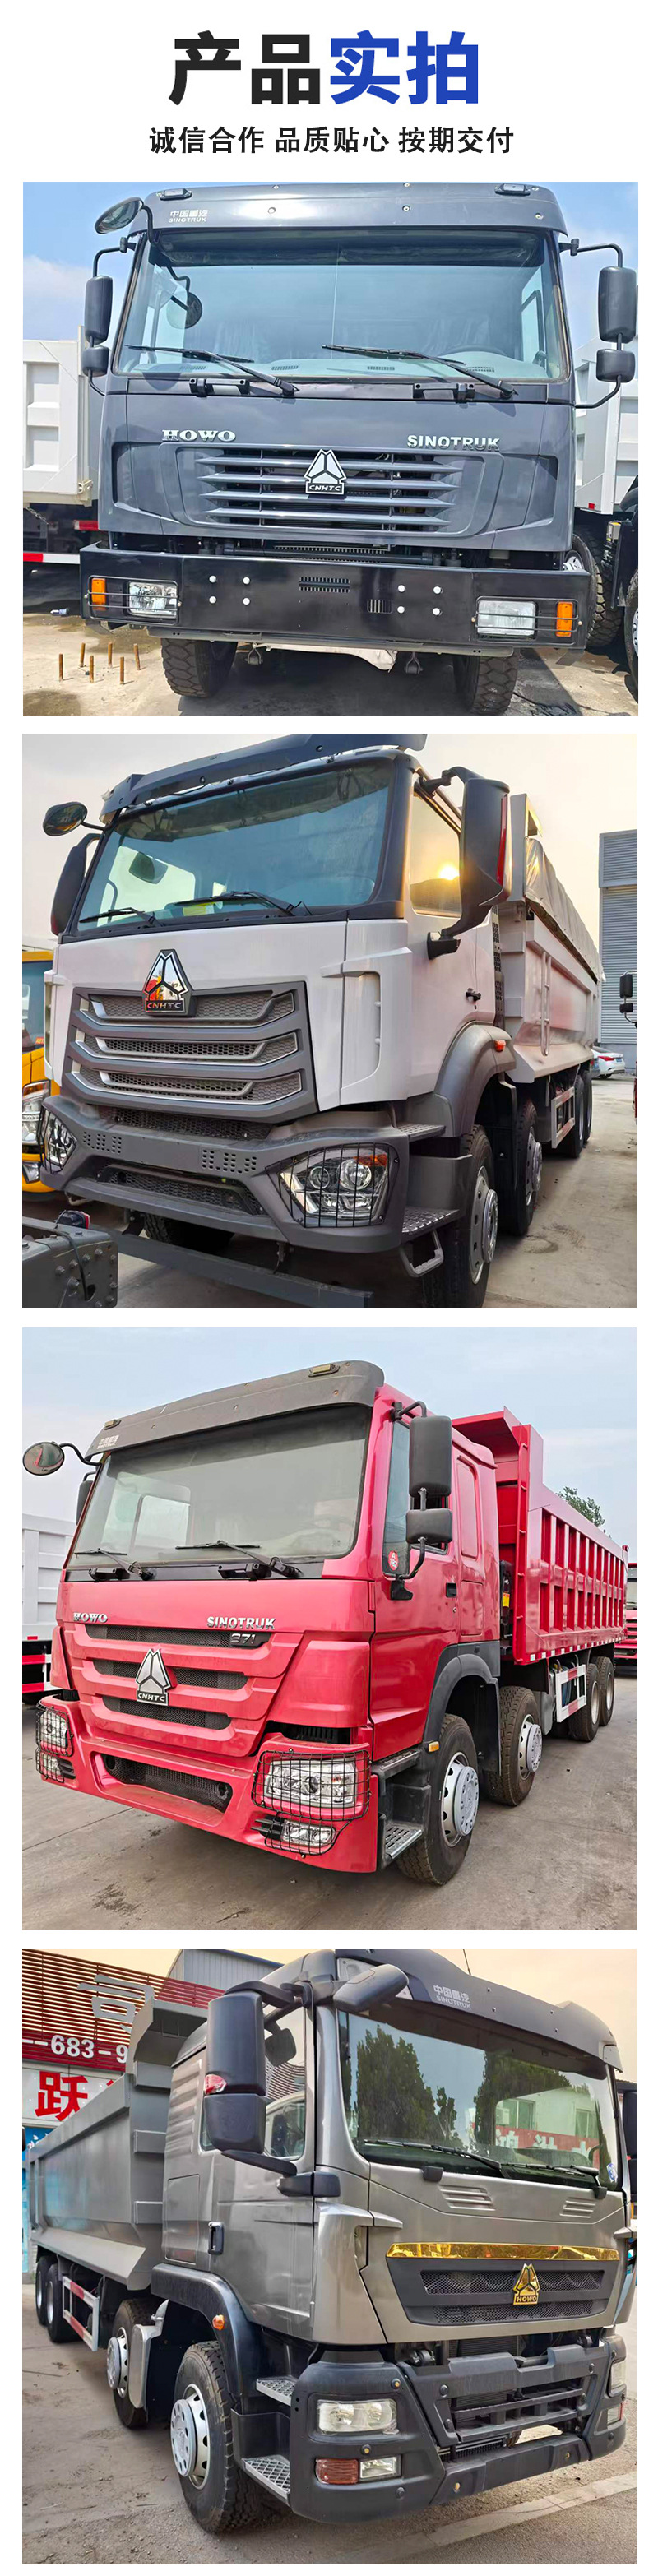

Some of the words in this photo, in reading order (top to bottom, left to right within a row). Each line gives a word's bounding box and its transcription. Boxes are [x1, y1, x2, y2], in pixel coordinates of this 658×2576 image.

[162, 429, 236, 442] HOWO
[407, 434, 500, 452] SINOTRUK
[73, 1612, 108, 1623] HOWO
[206, 1616, 276, 1629] SINOTRUK
[137, 1693, 165, 1702] CNHTC
[436, 1995, 472, 2011] SINOTRUK
